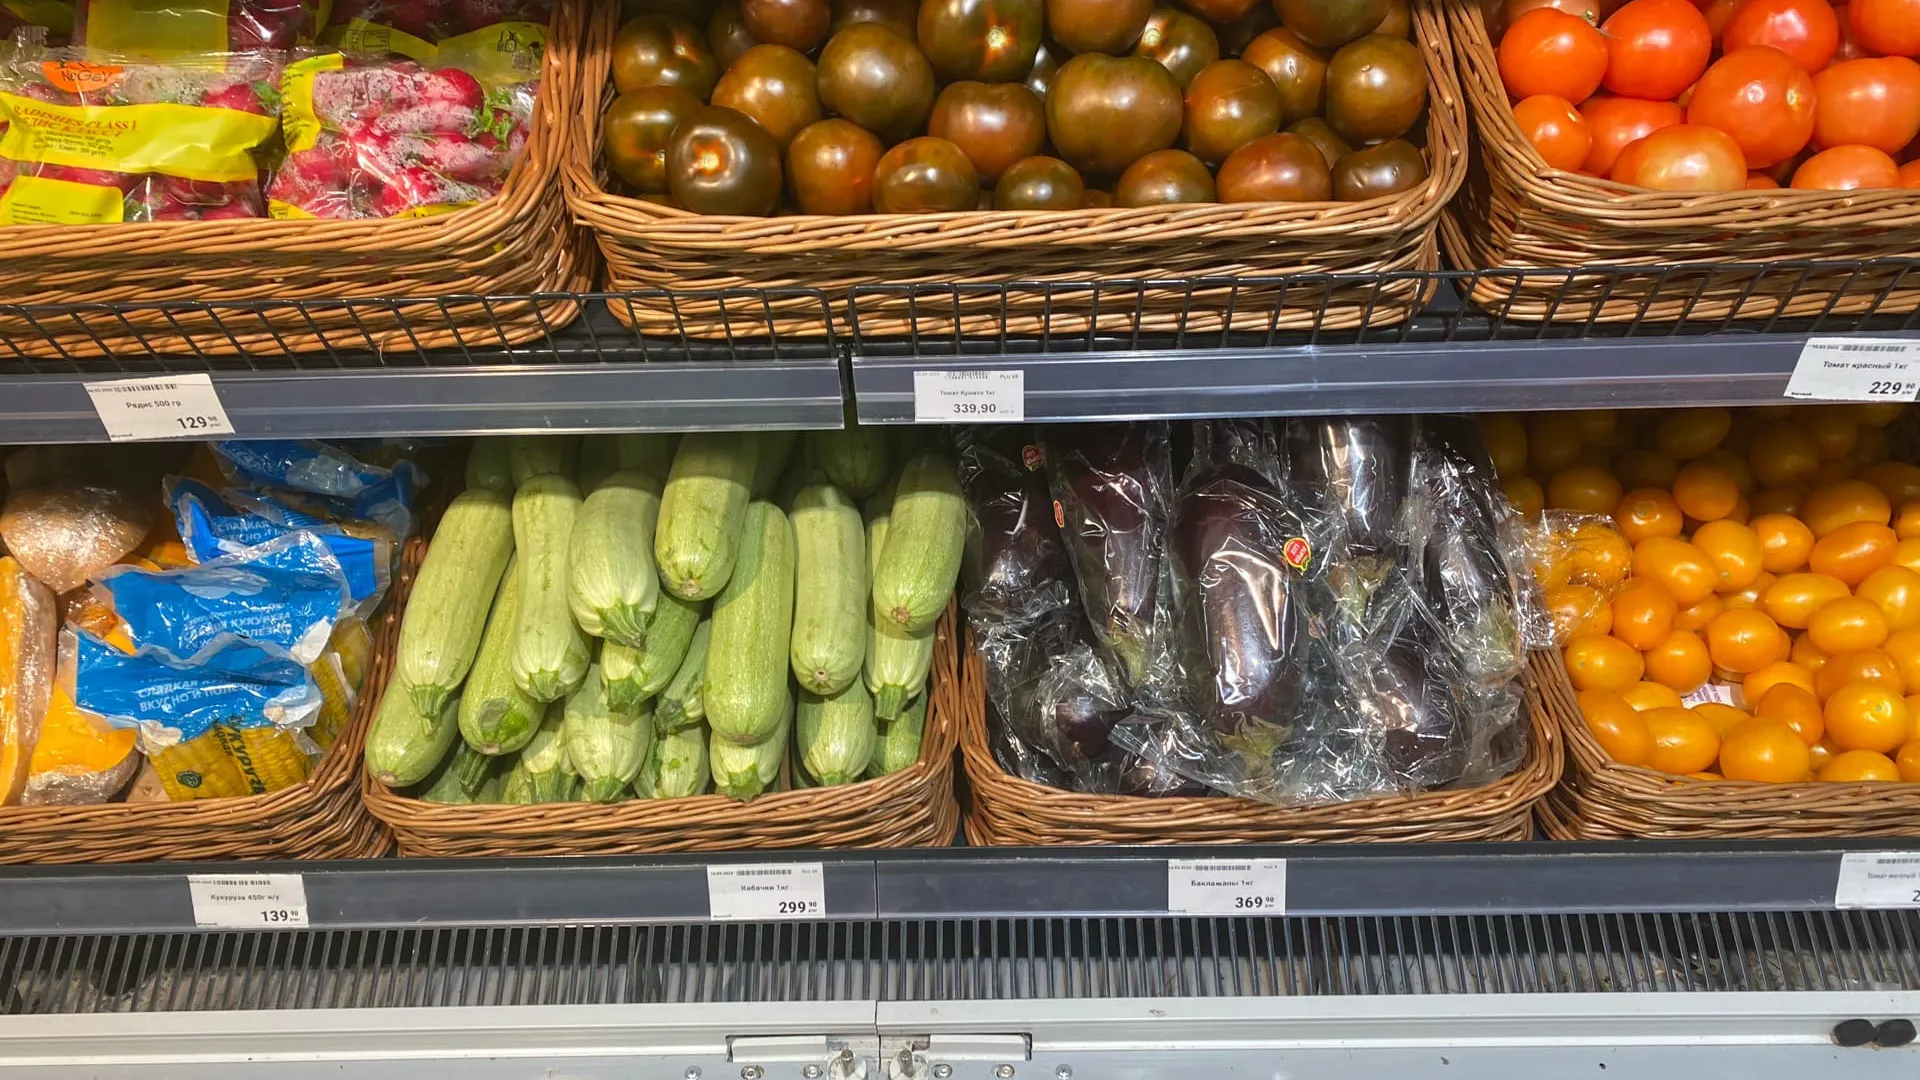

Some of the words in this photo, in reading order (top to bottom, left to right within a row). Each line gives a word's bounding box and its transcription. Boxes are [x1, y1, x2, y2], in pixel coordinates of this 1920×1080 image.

[83, 119, 129, 131] CLASS
[1851, 361, 1891, 369] красный
[1868, 381, 1903, 395] 229
[126, 400, 153, 409] Редис
[154, 400, 170, 408] 500
[171, 400, 182, 408] гр
[953, 403, 997, 415] 339,90
[176, 416, 207, 430] 129
[139, 693, 190, 712] ВКУСНО
[778, 901, 806, 914] 299
[1235, 896, 1263, 909] 369
[260, 910, 288, 922] 139
